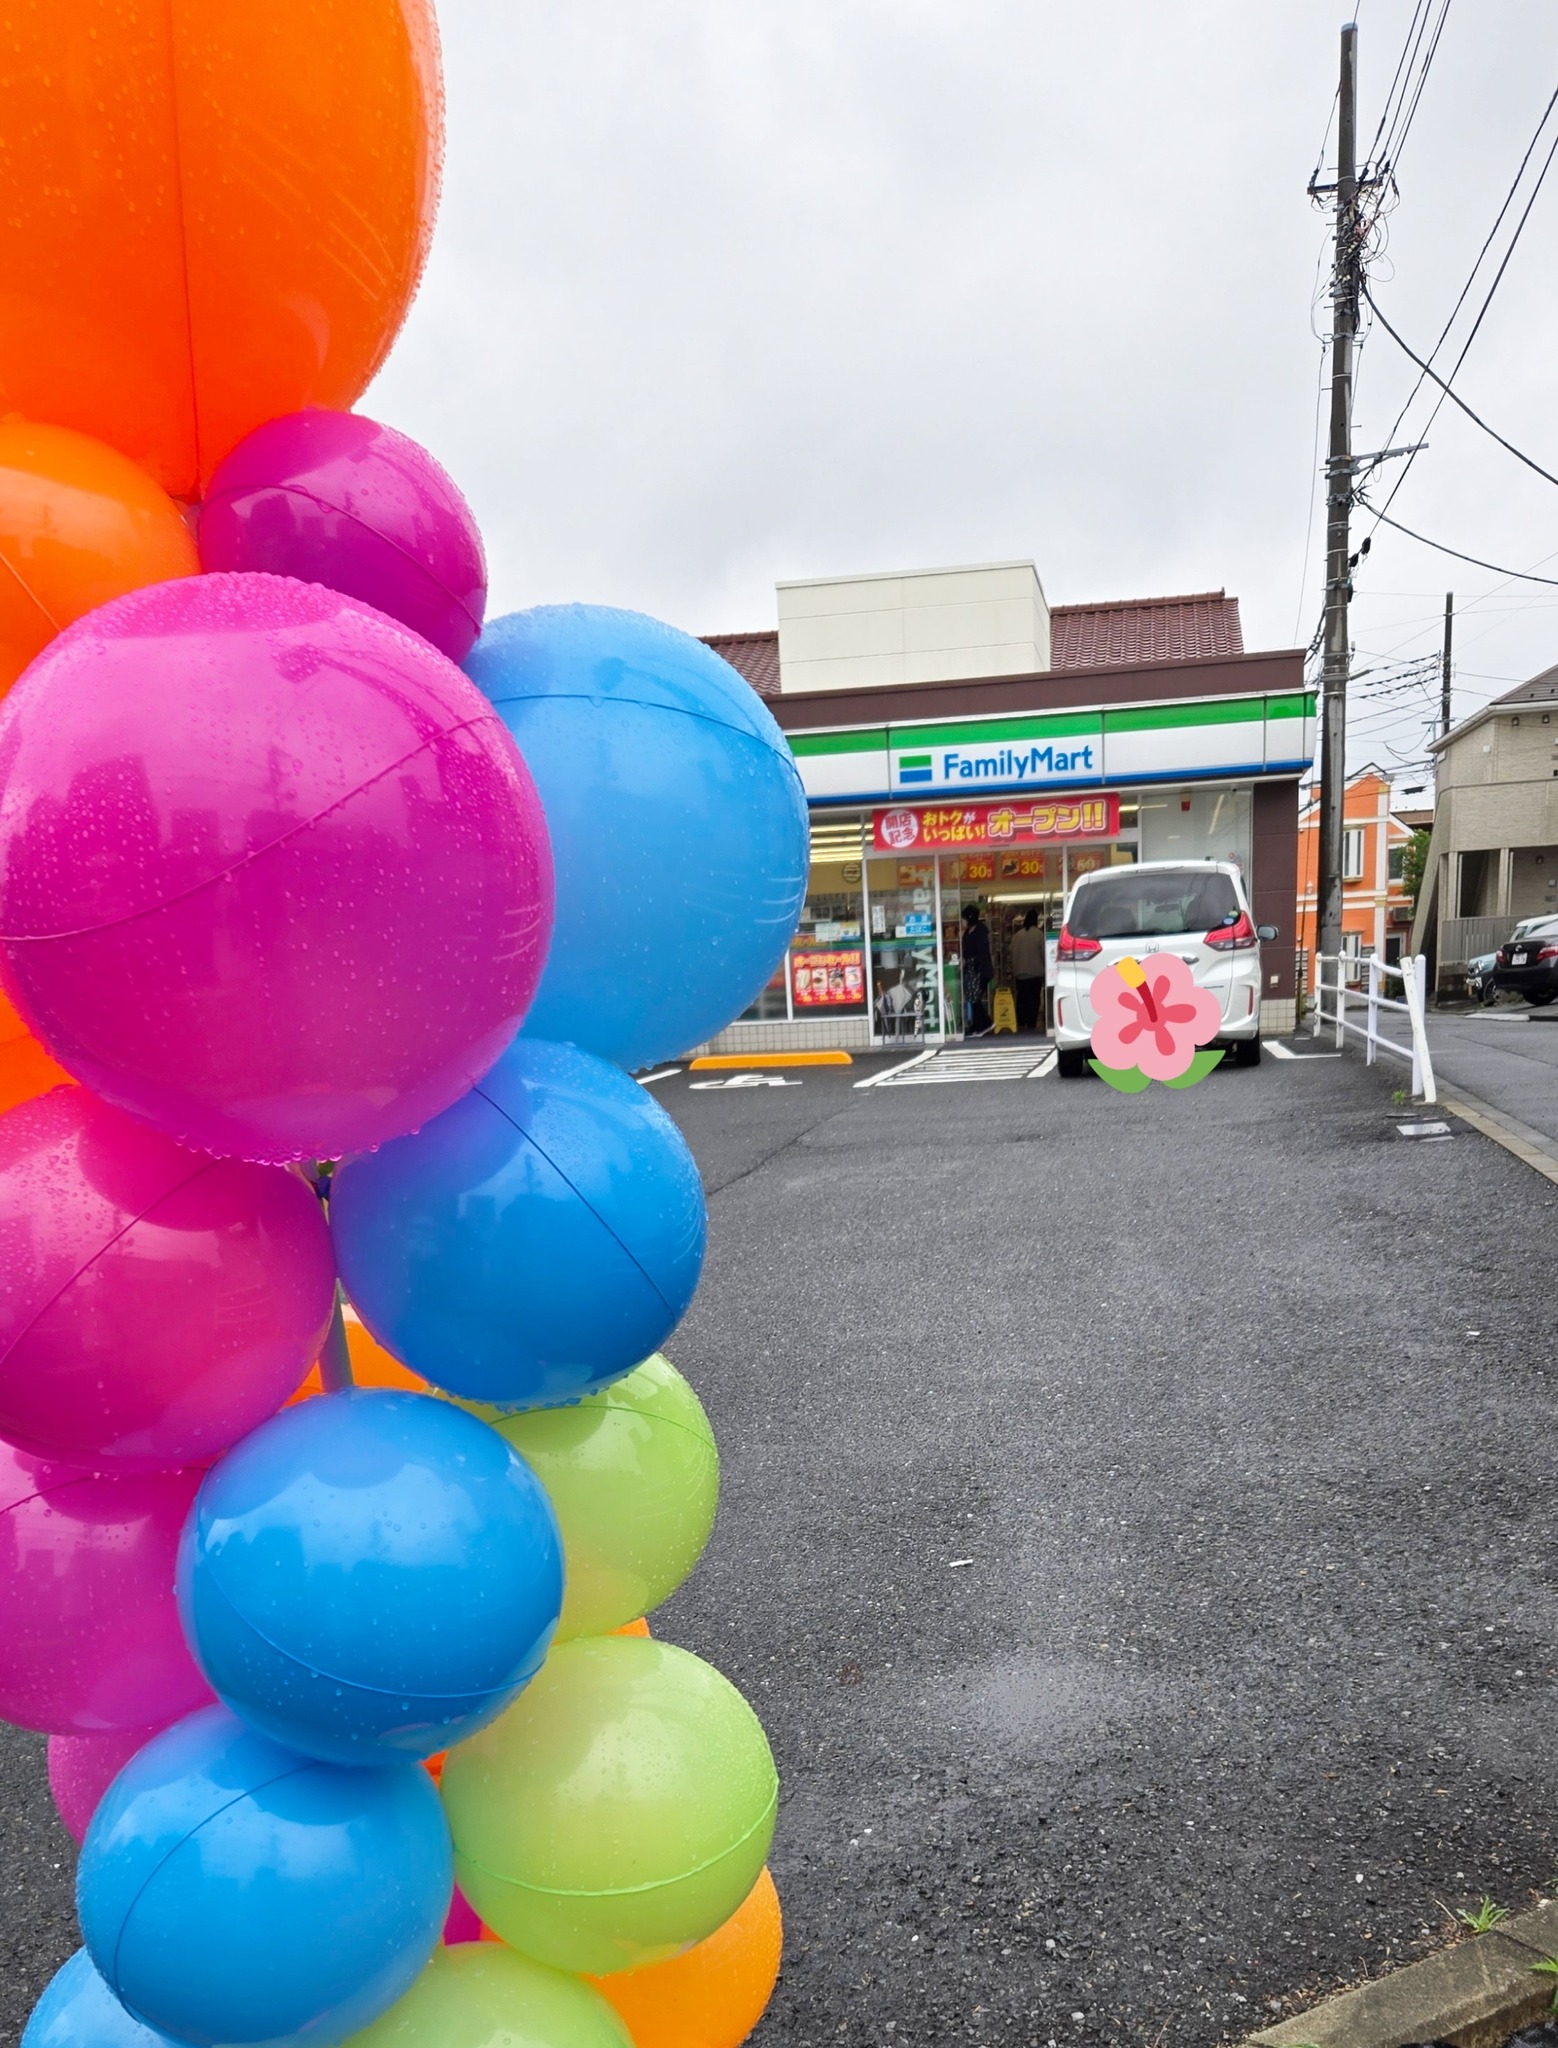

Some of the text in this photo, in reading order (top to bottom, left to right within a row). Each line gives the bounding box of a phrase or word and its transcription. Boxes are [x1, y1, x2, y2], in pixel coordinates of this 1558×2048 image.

[944, 745, 1093, 779] FamilyMart
[886, 812, 912, 830] 開店
[923, 811, 976, 827] おトクが
[988, 800, 1105, 836] オープン!!
[889, 827, 915, 845] 記念
[923, 824, 986, 843] いっぱい!
